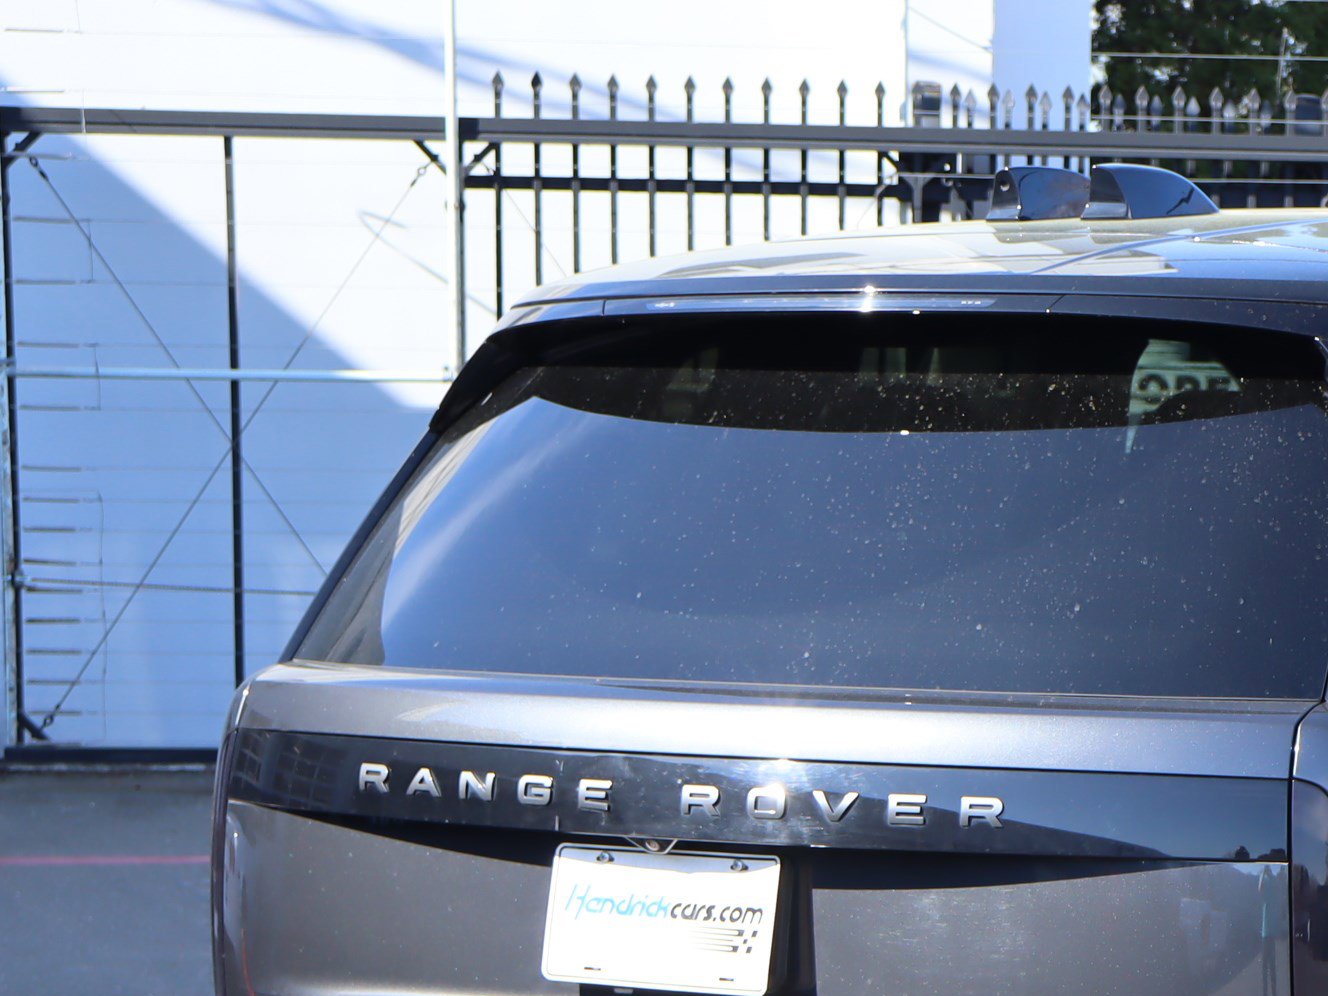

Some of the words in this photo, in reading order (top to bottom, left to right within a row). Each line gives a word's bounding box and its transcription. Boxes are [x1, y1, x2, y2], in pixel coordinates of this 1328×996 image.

[358, 762, 614, 813] RANGE
[681, 783, 1006, 830] ROVER
[565, 882, 764, 925] Hendrickcars.com
